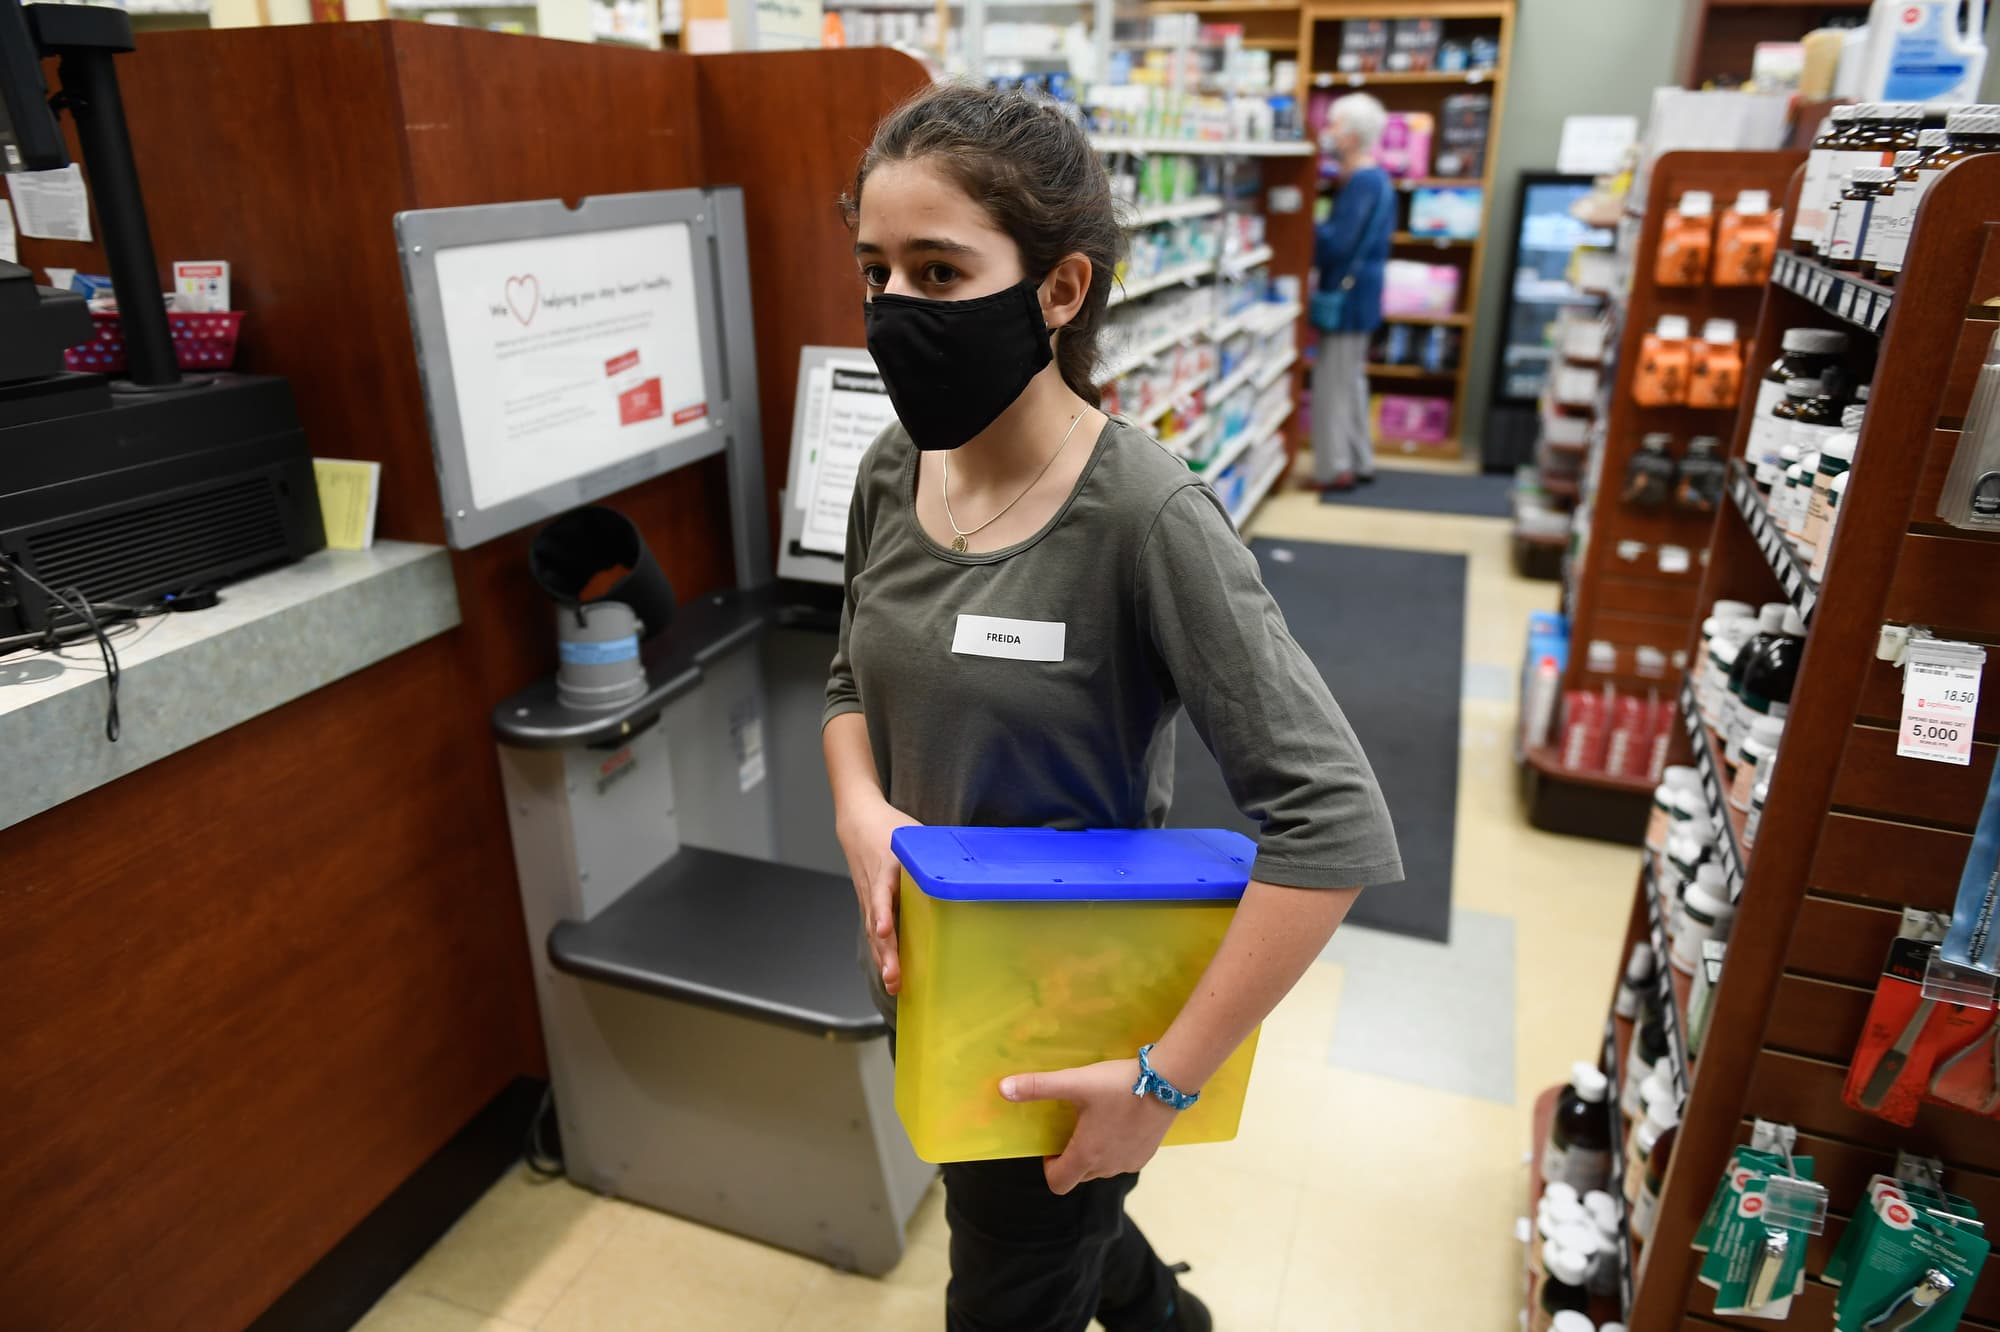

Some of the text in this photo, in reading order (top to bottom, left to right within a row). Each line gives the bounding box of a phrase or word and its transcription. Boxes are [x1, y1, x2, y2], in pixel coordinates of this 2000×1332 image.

[986, 632, 1021, 644] FREIDA
[1944, 689, 1975, 703] 18.50
[1912, 724, 1958, 741] 5,000
[1932, 1242, 1967, 1264] Clipper
